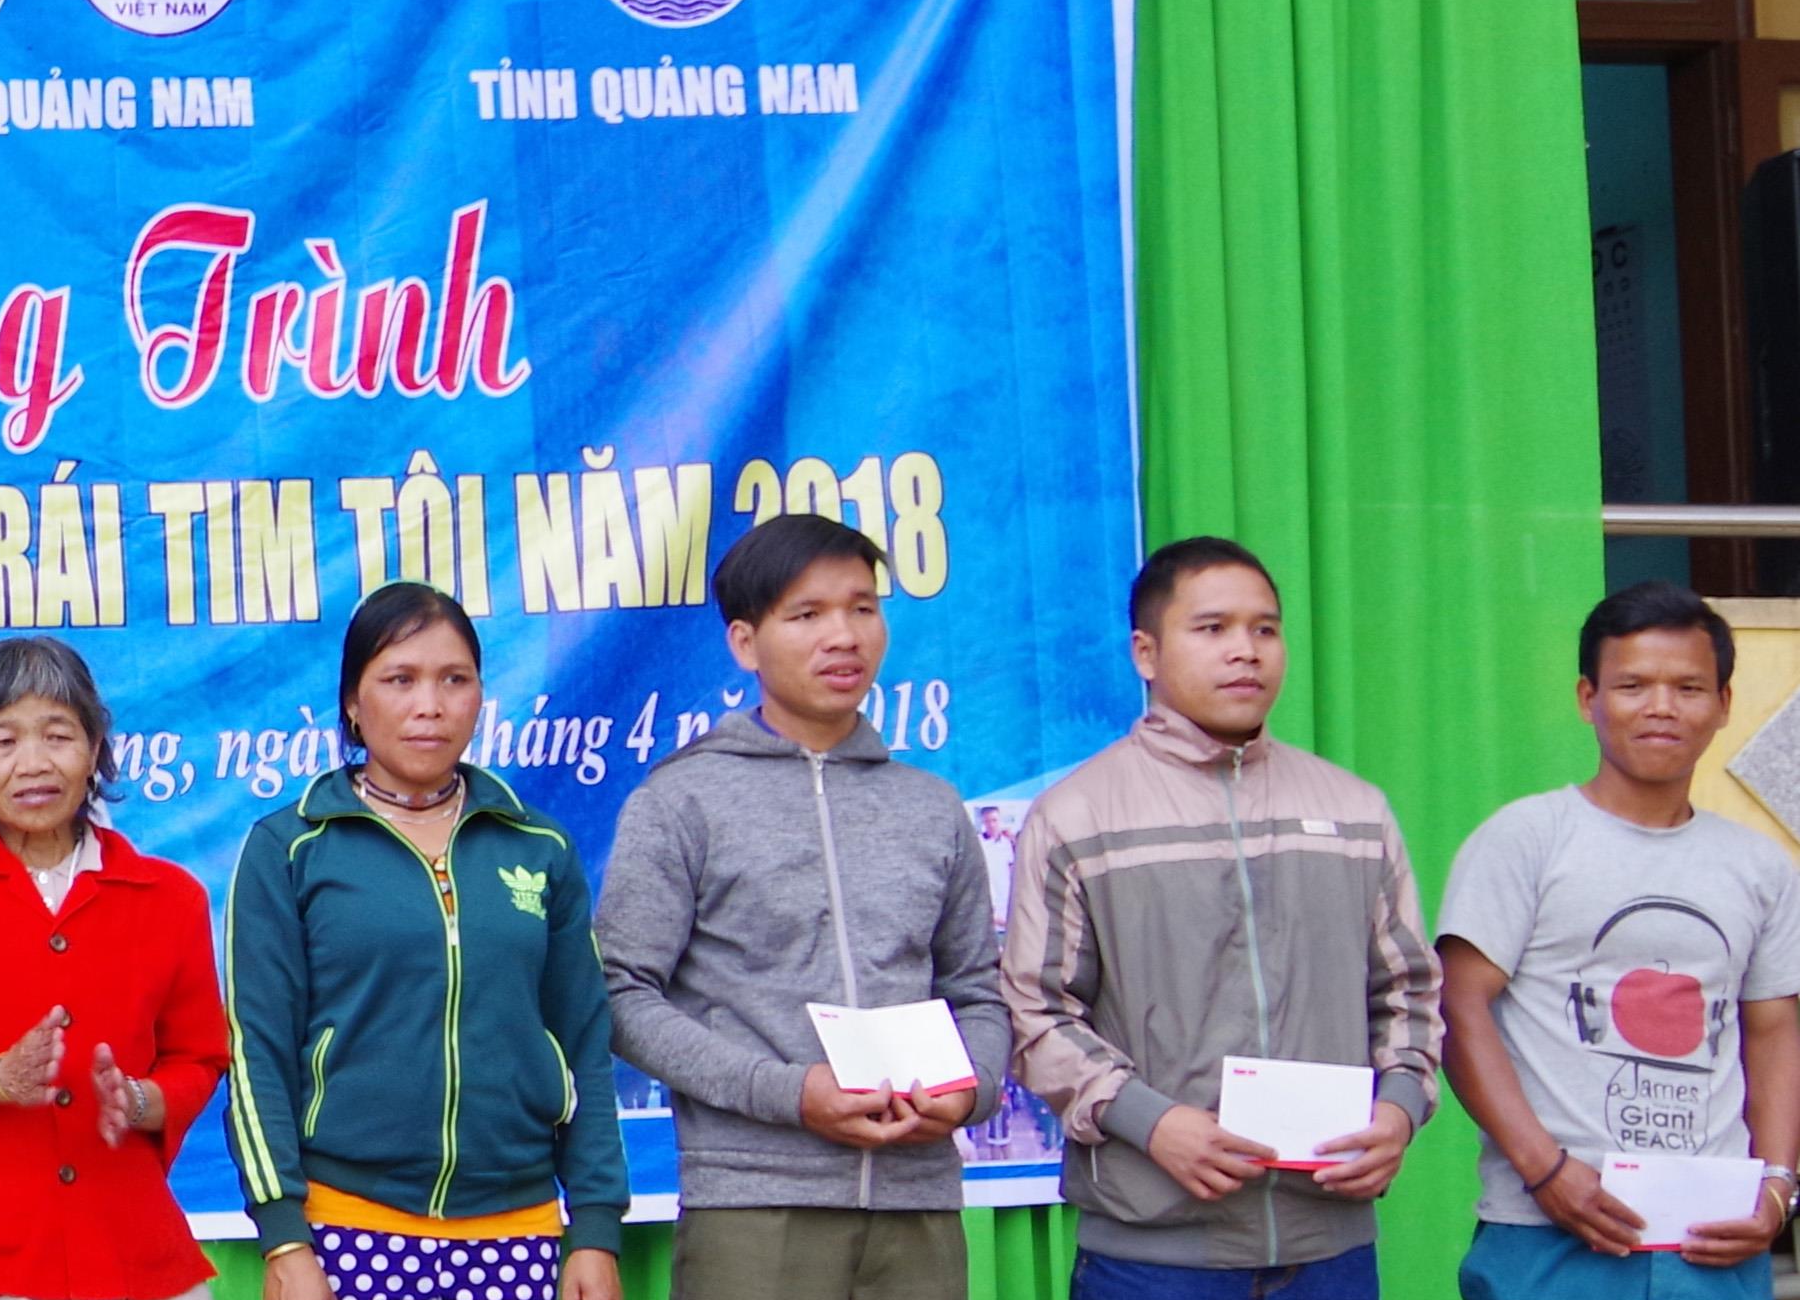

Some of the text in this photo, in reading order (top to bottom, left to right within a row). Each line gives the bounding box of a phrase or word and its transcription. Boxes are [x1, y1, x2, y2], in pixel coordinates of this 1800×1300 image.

[166, 1, 207, 16] NAM
[151, 76, 255, 129] NAM
[469, 55, 860, 124] TỈNH QUẢNG NAM
[124, 198, 531, 411] Trình
[148, 479, 322, 624] TIM
[338, 449, 490, 618] TÔI
[513, 445, 713, 614] NĂM
[462, 694, 613, 786] háng
[626, 690, 659, 765] 4
[1620, 1104, 1695, 1131] Giant
[1620, 1128, 1698, 1151] PEACH
